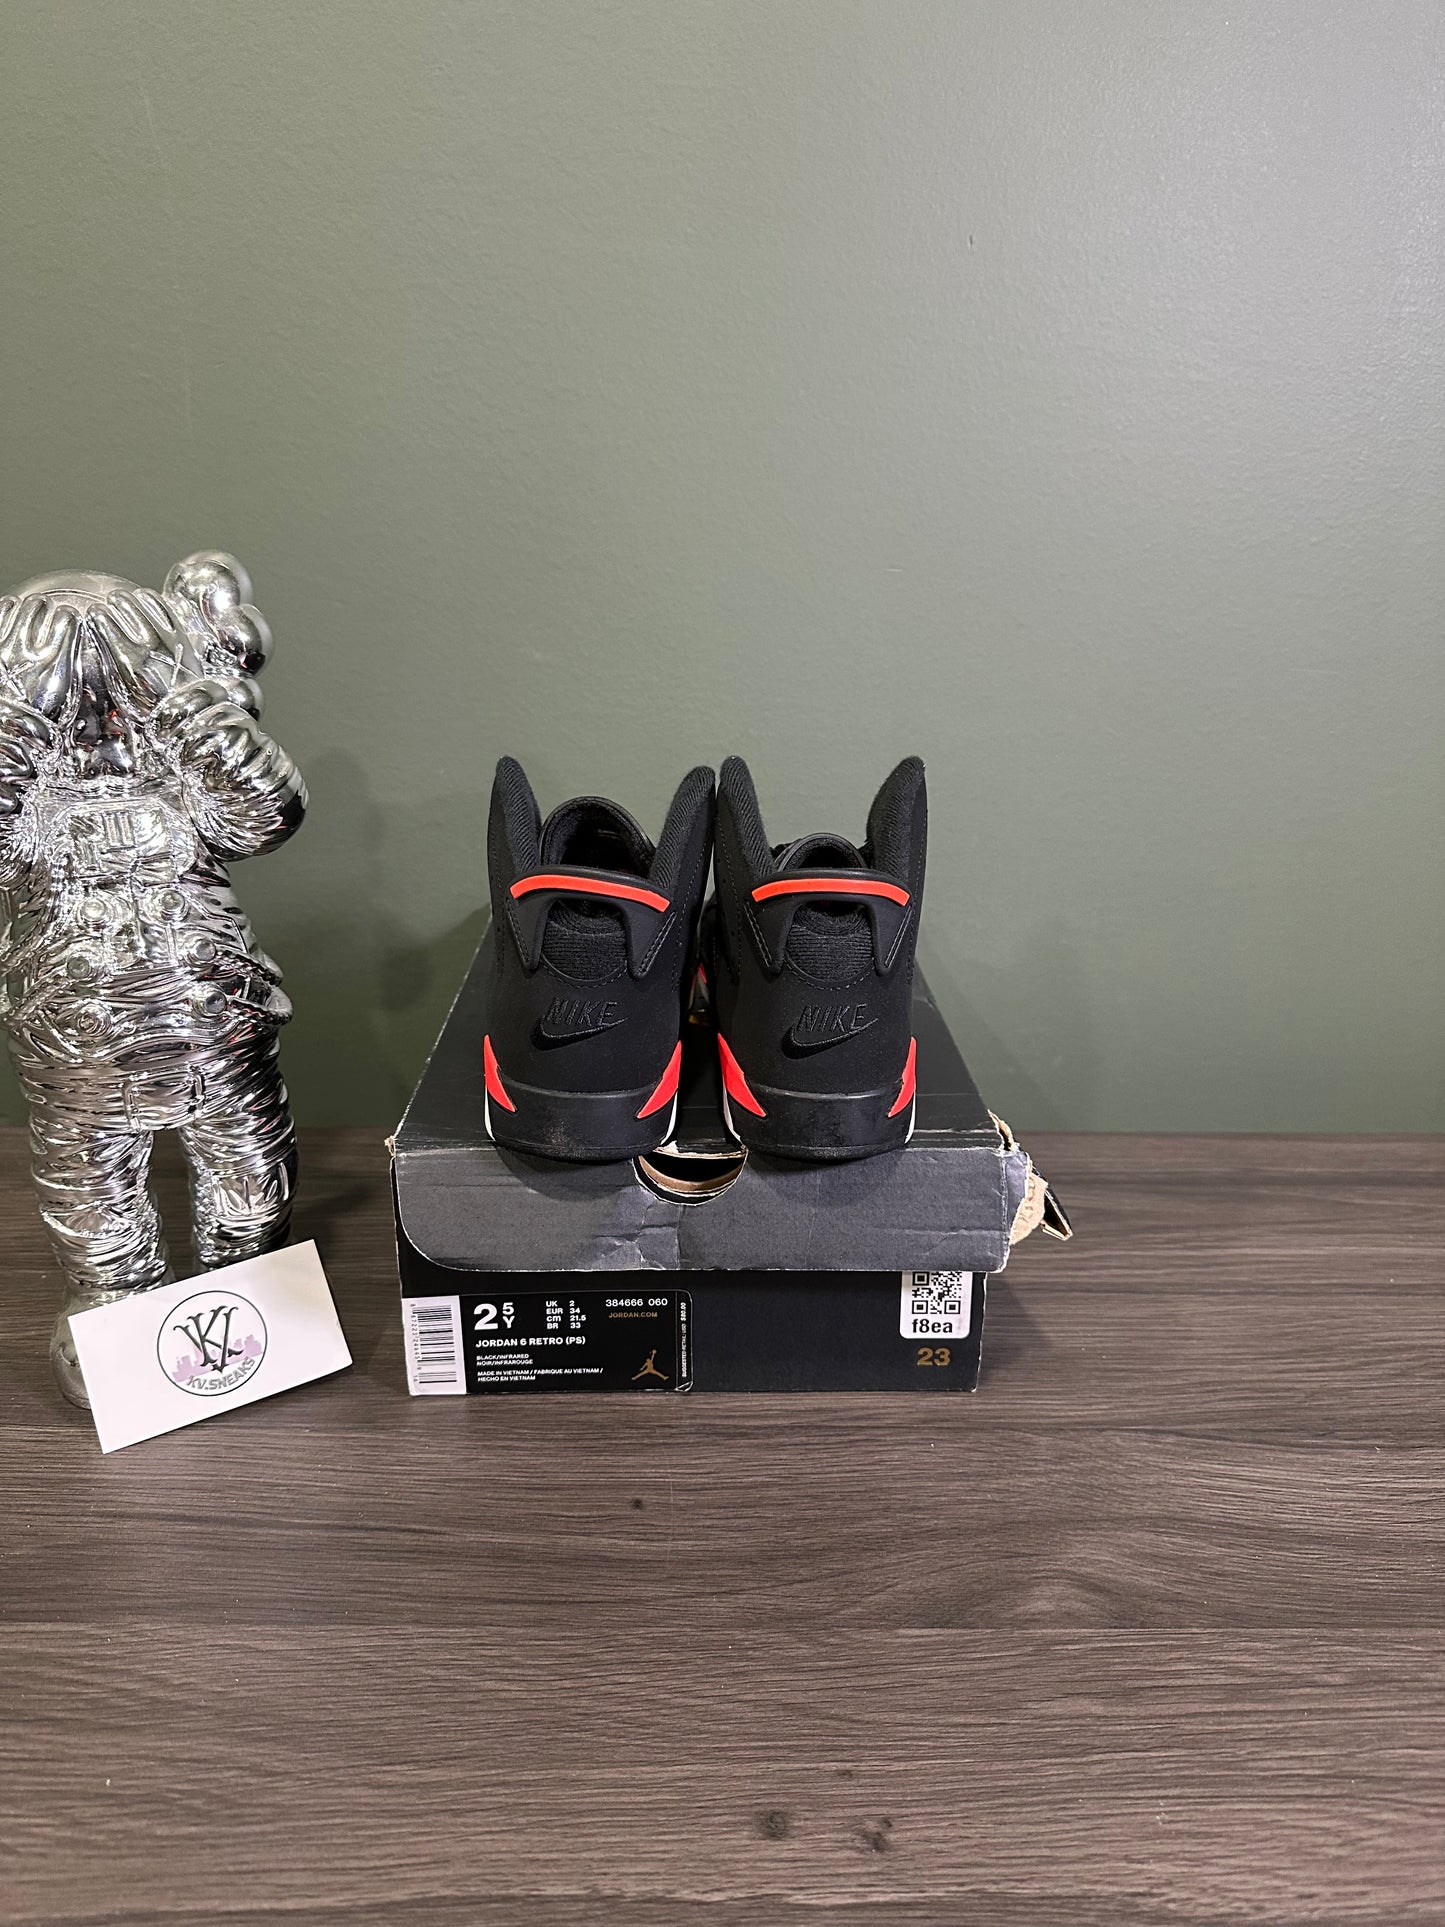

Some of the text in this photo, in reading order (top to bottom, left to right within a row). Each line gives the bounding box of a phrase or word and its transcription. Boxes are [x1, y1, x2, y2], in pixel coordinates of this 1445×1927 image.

[548, 997, 618, 1026] NIKE
[800, 1003, 867, 1032] NIKE
[502, 1302, 515, 1315] 5
[605, 1298, 668, 1307] 384666 060
[473, 1303, 499, 1331] 2
[546, 1307, 563, 1315] EUR
[608, 1311, 658, 1319] JORDAN.COM
[502, 1315, 515, 1329] Y
[569, 1314, 587, 1322] 21.5
[546, 1322, 559, 1330] BR
[911, 1318, 953, 1333] f8ea
[475, 1336, 586, 1348] JORDAN 6 RETRO (PS)
[476, 1353, 530, 1361] BLACK/INFRARED
[917, 1347, 951, 1366] 23
[186, 1357, 255, 1391] KV.SNEAKS
